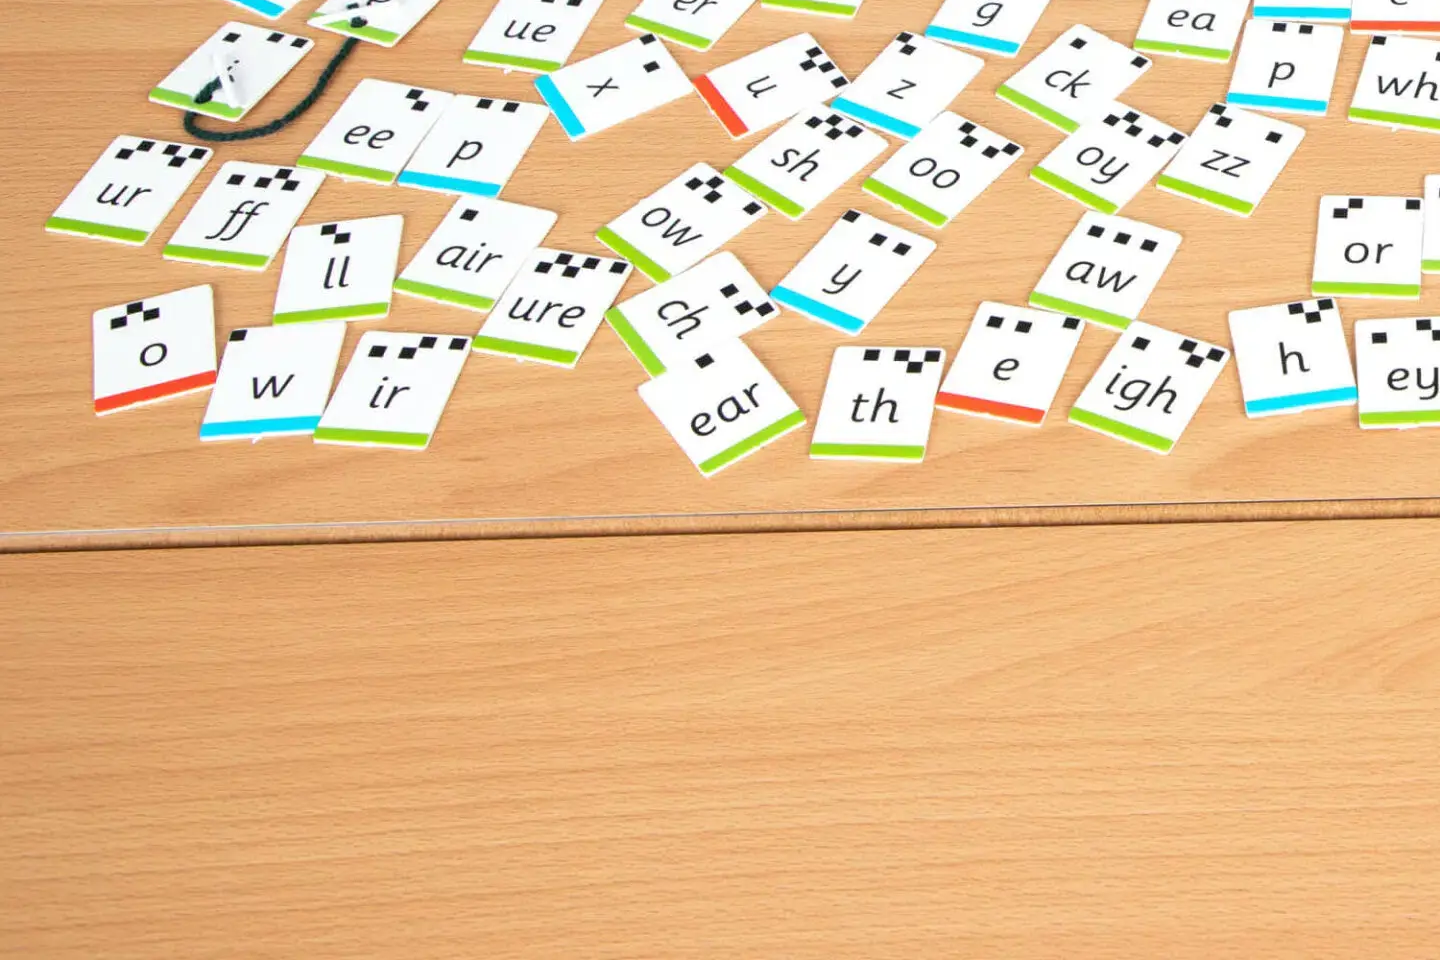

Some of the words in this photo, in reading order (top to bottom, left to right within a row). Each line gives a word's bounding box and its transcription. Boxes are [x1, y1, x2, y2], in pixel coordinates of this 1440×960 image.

[972, 2, 1004, 27] g
[1167, 9, 1216, 32] ea
[503, 20, 557, 43] ue
[586, 77, 619, 98] x
[746, 75, 777, 99] u
[886, 79, 917, 100] z
[1044, 69, 1090, 99] ck
[1267, 61, 1296, 89] p
[1378, 71, 1439, 102] wh
[343, 125, 395, 150] ee
[446, 140, 483, 169] p
[770, 148, 820, 182] sh
[1076, 146, 1130, 185] oy
[1200, 149, 1251, 178] zz
[909, 157, 961, 189] oo
[96, 183, 152, 207] ur
[204, 200, 270, 242] ff
[641, 207, 703, 247] ow
[436, 242, 503, 273] air
[1344, 242, 1394, 264] or
[822, 263, 862, 295] y
[1065, 261, 1137, 293] aw
[508, 297, 586, 329] ure
[657, 300, 709, 340] ch
[139, 342, 168, 367] o
[992, 358, 1020, 381] e
[1278, 341, 1310, 375] h
[252, 374, 295, 400] w
[369, 376, 411, 409] ir
[1105, 364, 1177, 415] igh
[1387, 366, 1439, 401] ey
[690, 382, 759, 437] ear
[851, 387, 899, 424] th
